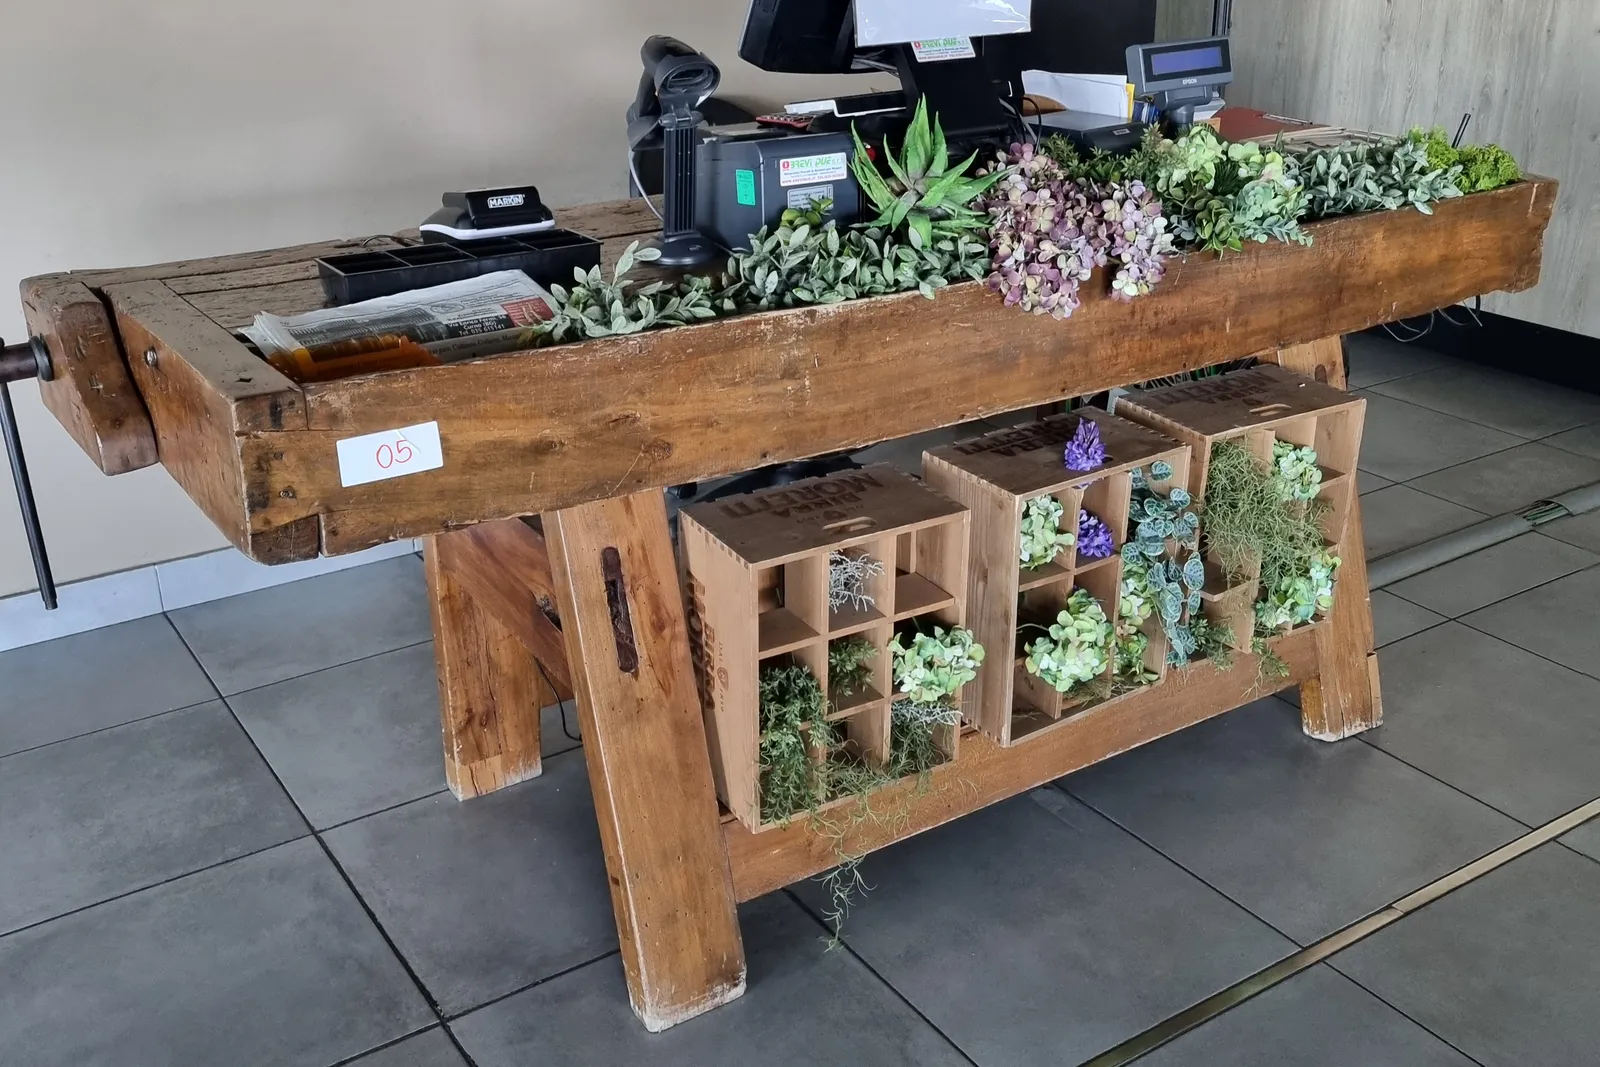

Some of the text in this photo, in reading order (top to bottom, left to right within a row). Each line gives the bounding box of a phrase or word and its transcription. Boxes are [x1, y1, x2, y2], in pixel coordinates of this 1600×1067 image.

[376, 439, 413, 469] 05
[718, 472, 884, 518] MORETTI
[770, 490, 863, 518] BIRRA
